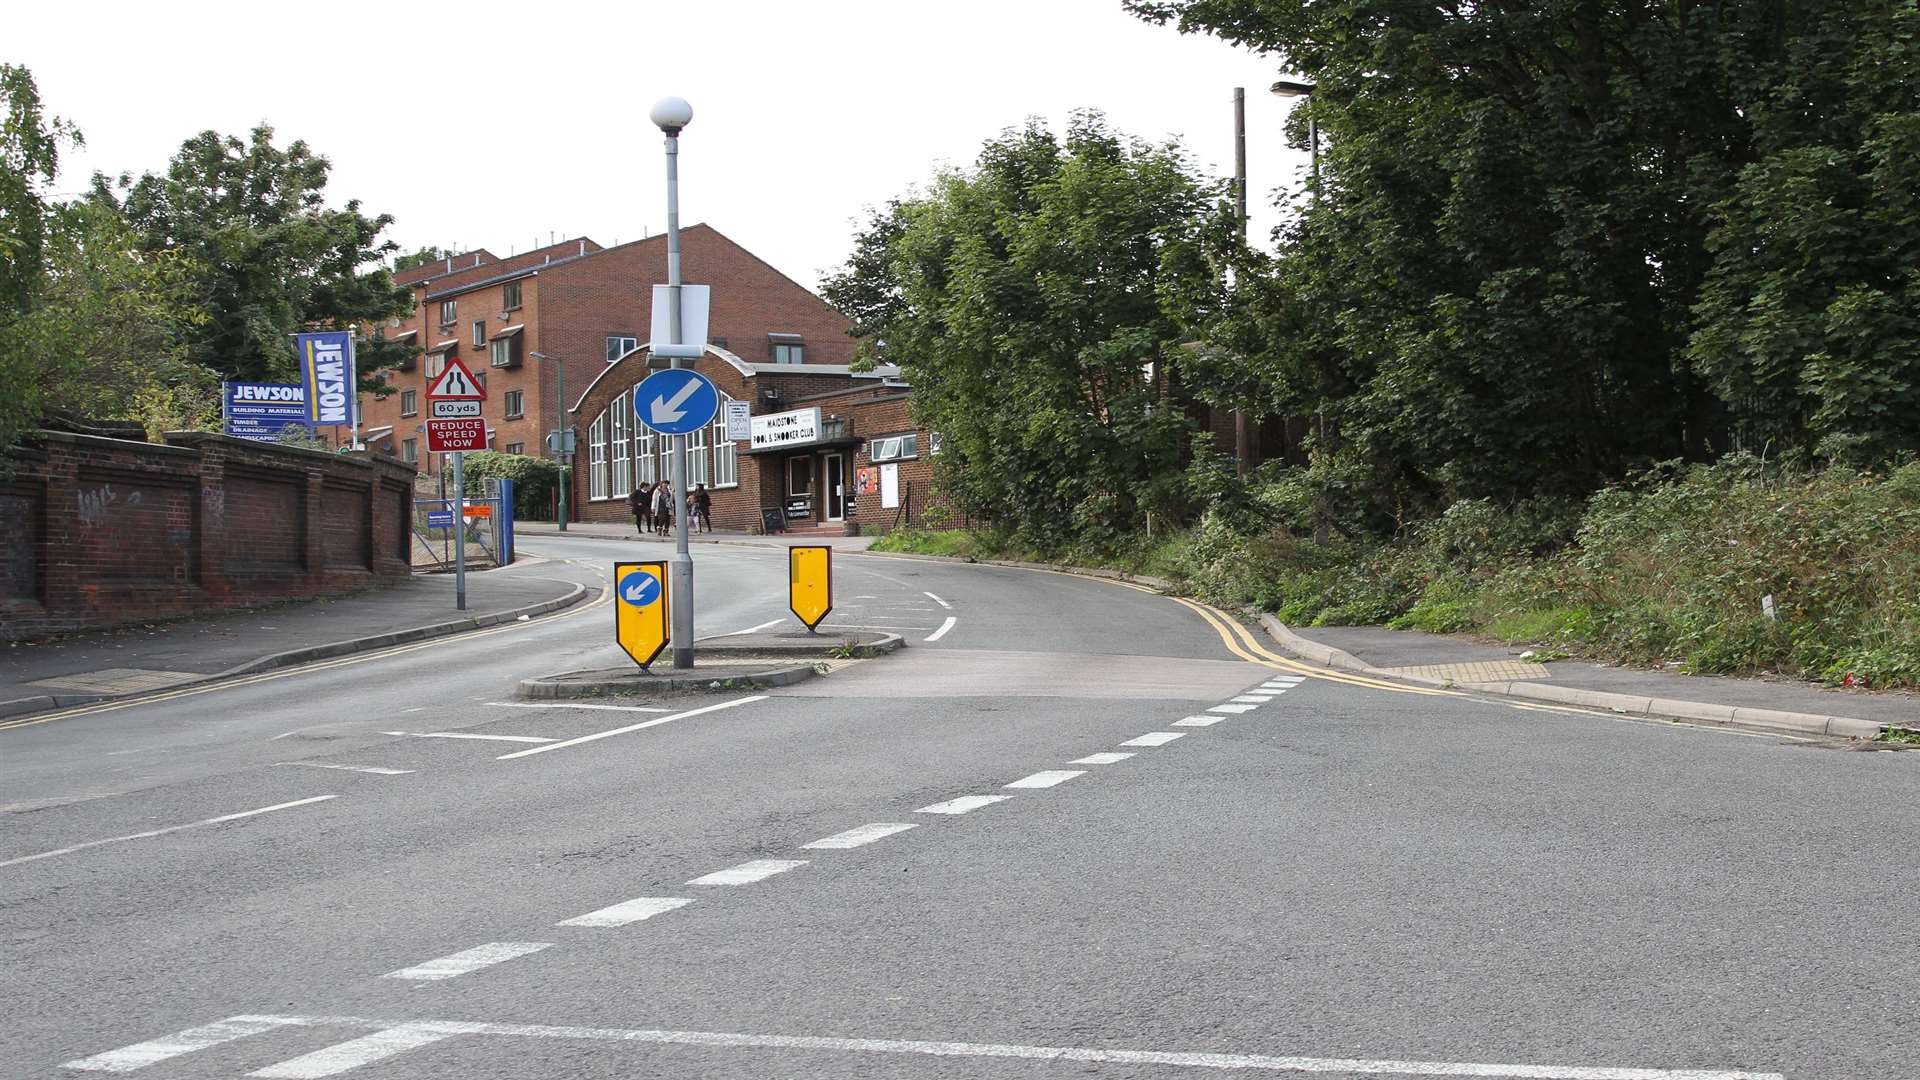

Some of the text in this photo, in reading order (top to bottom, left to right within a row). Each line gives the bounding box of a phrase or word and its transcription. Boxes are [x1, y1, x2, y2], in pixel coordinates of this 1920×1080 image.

[314, 340, 346, 422] JEWSON
[233, 386, 304, 401] JEWSON
[439, 404, 476, 413] 60 yds
[431, 421, 481, 430] REDUCE
[767, 415, 798, 428] MAIDSTONE
[437, 430, 477, 439] SPEED
[753, 435, 767, 443] POOL
[774, 430, 799, 442] SNOOKER
[800, 427, 814, 438] CLUB
